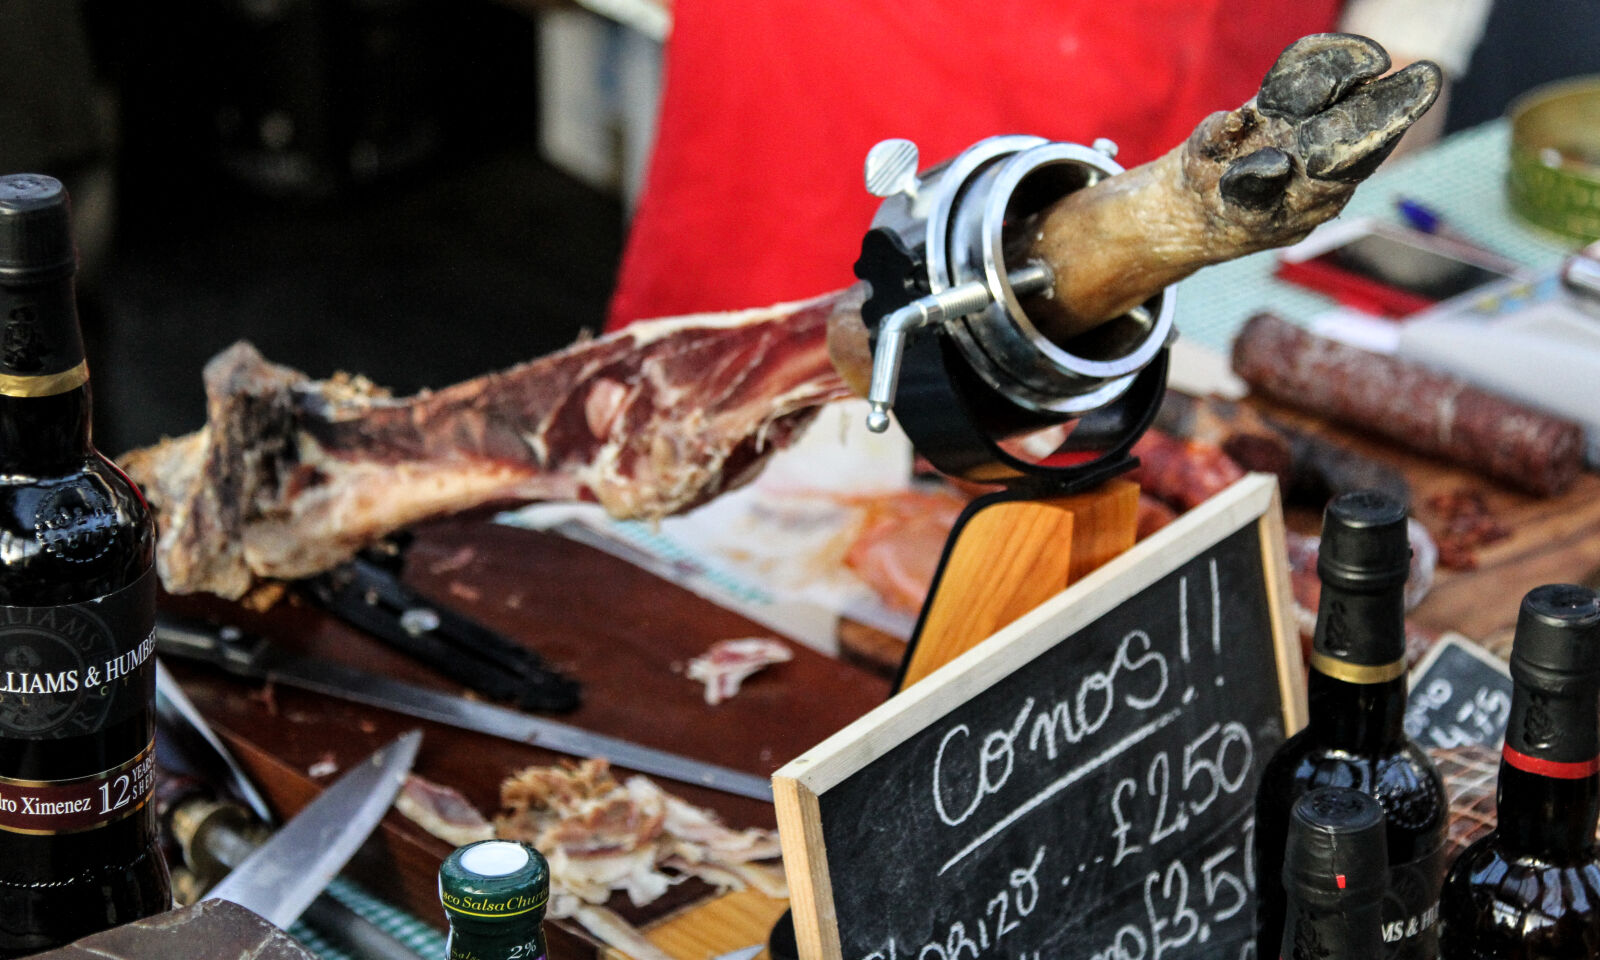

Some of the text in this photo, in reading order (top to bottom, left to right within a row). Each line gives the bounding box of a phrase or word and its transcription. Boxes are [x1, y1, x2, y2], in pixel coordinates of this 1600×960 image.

[0, 670, 79, 694] LIAMS
[84, 665, 102, 689] &
[105, 626, 157, 683] HUMBE
[20, 795, 92, 816] Ximenez
[98, 774, 131, 815] 12
[442, 890, 461, 906] sco
[461, 896, 505, 912] Salsa
[506, 939, 537, 960] 2%
